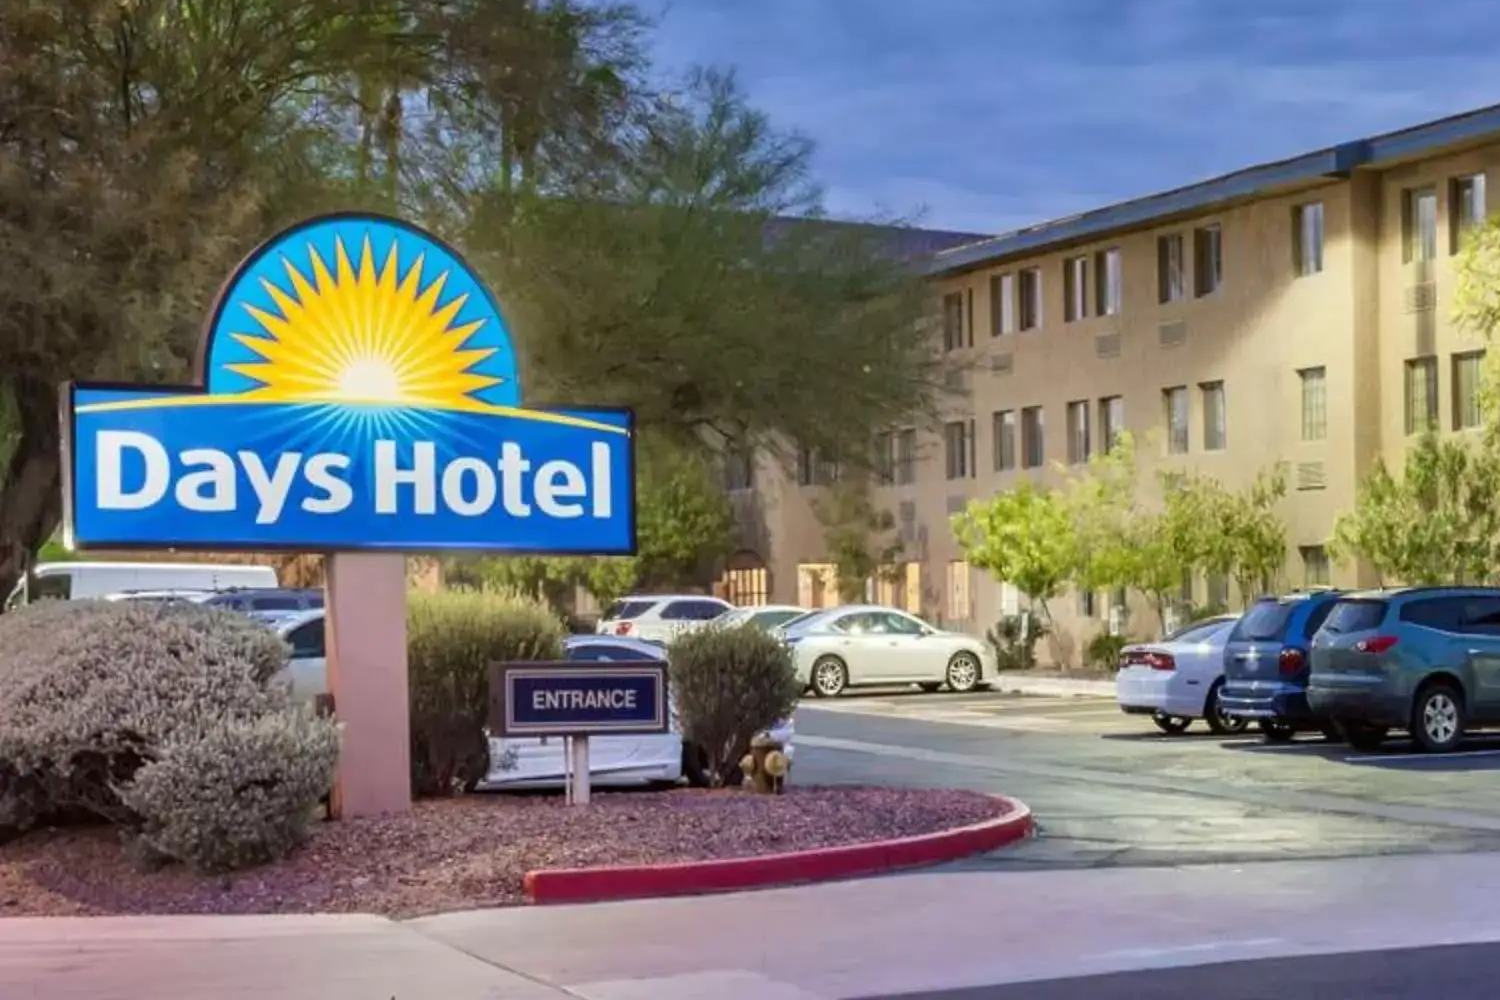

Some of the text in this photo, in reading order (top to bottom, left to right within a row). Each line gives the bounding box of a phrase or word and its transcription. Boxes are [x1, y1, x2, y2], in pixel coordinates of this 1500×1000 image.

[95, 430, 612, 525] Days Hotel
[532, 688, 637, 710] ENTRANCE
